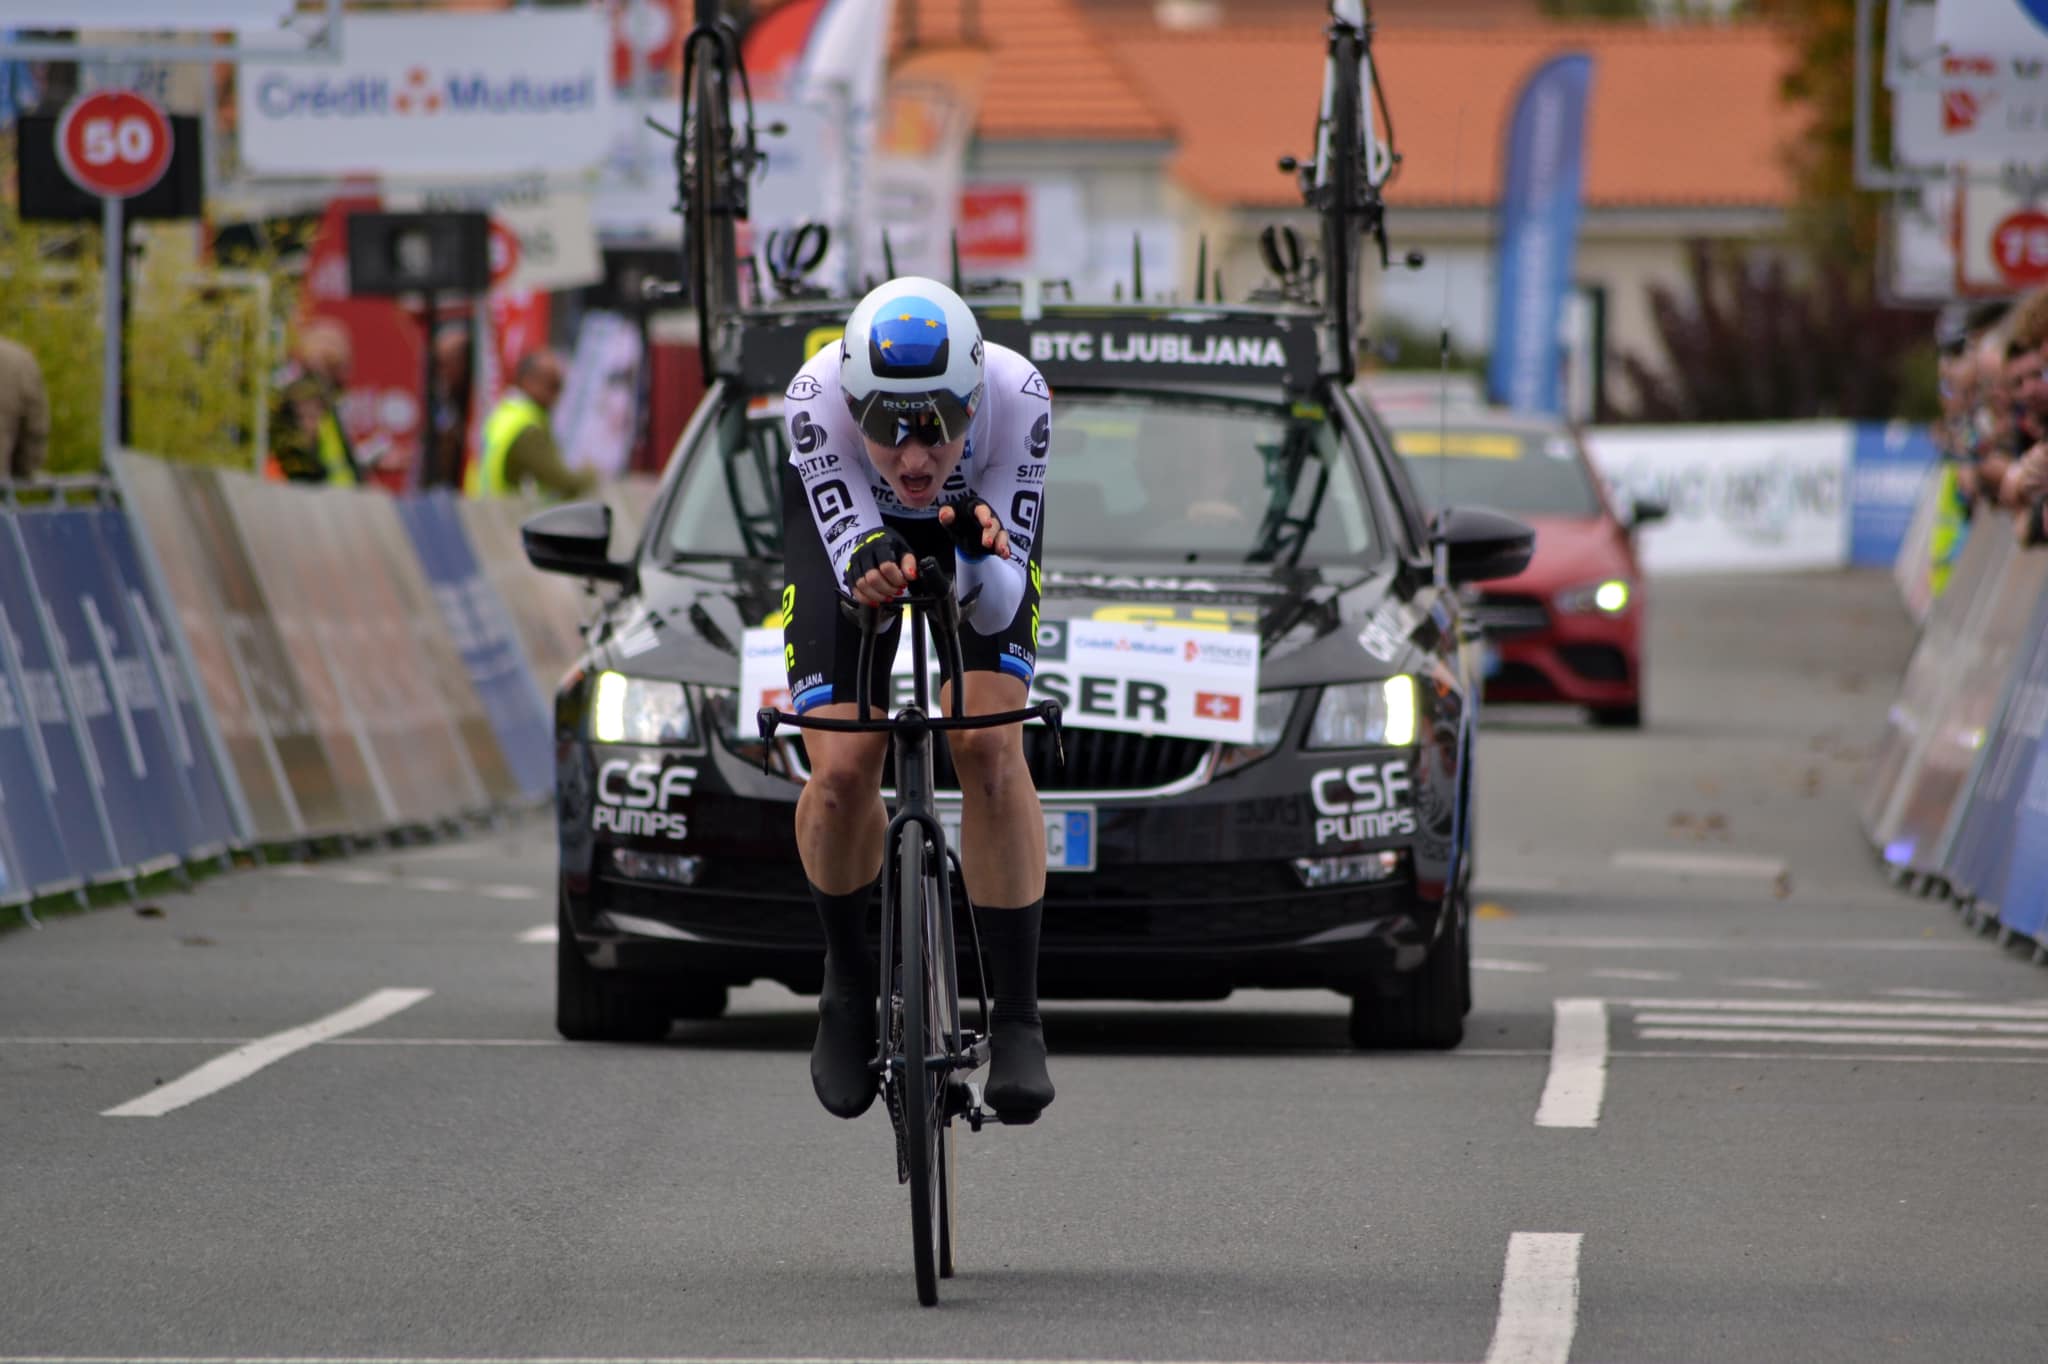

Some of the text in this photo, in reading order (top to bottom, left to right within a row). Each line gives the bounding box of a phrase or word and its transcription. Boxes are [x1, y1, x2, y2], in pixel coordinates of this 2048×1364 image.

[447, 68, 596, 116] Mutuel
[83, 116, 155, 167] 50
[1029, 332, 1287, 368] BTC LJUBLJANA
[792, 381, 822, 396] FTC
[882, 399, 936, 410] RUDY
[598, 760, 698, 810] CSF
[1311, 761, 1410, 816] CSF
[592, 804, 688, 840] PUMPS
[1315, 808, 1417, 845] PUMPS
